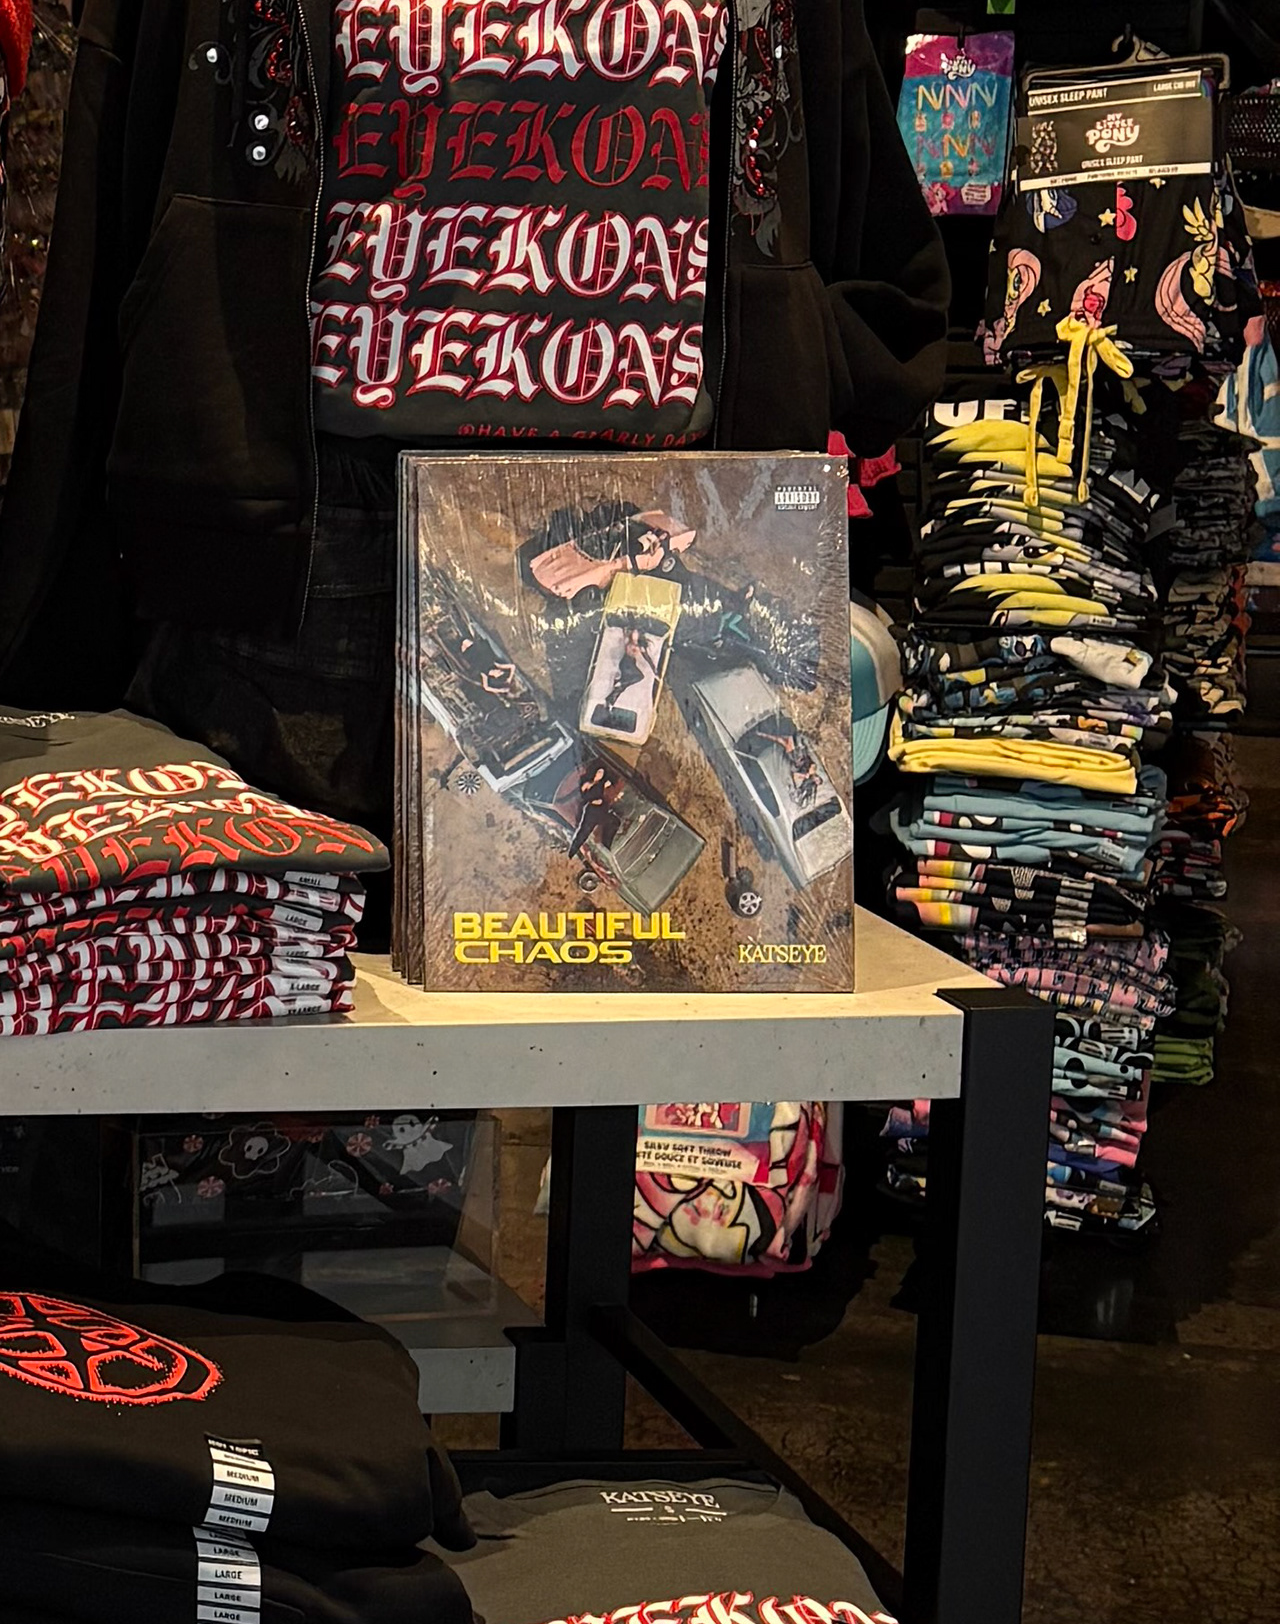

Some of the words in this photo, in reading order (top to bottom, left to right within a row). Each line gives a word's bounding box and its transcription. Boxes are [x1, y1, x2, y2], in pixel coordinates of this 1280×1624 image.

[1060, 90, 1085, 103] SLEEP
[1087, 87, 1108, 99] PANT
[1096, 117, 1134, 130] LITTLE
[1085, 125, 1140, 153] PONY
[285, 915, 308, 926] LARGE
[453, 911, 687, 941] BEAUTIFUL
[454, 940, 634, 965] CHAOS
[738, 943, 828, 964] KATSEYE
[226, 1470, 259, 1483] MEDIUM
[224, 1493, 258, 1506] MEDIUM
[600, 1490, 721, 1510] KATSEYE
[219, 1515, 252, 1527] MEDIUM
[215, 1570, 242, 1579] LARGE
[214, 1592, 241, 1602] LARGE
[214, 1611, 240, 1621] LARGE
